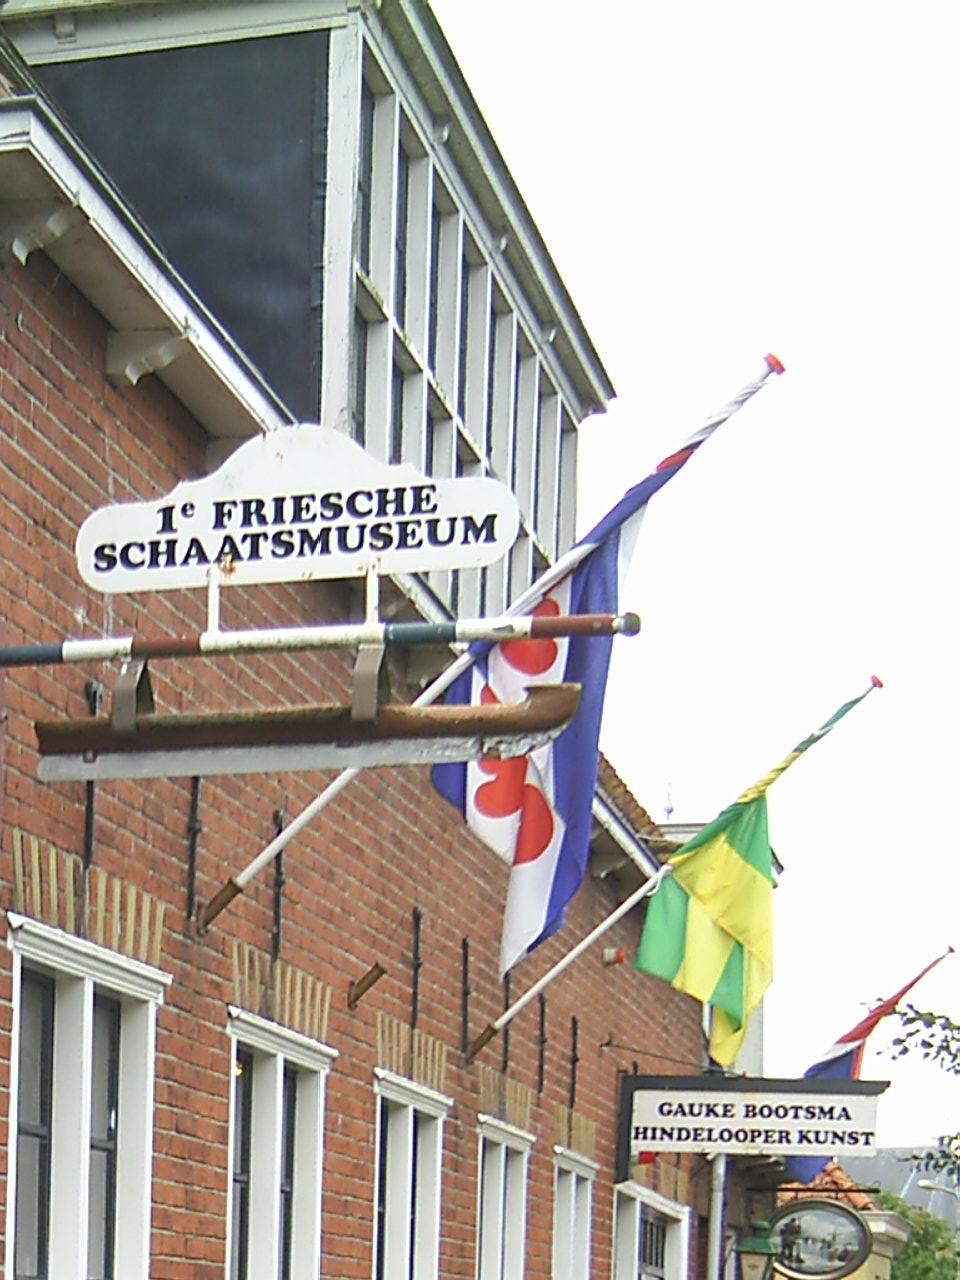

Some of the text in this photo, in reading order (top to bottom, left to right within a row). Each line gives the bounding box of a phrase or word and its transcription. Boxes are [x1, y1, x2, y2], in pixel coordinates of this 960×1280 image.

[213, 484, 440, 530] FRIESCHE
[93, 513, 499, 573] SCHAATSMUSEUM
[658, 1102, 852, 1121] GAUKE BOOTSMA
[633, 1126, 875, 1146] HINDELOOPER KUNST
